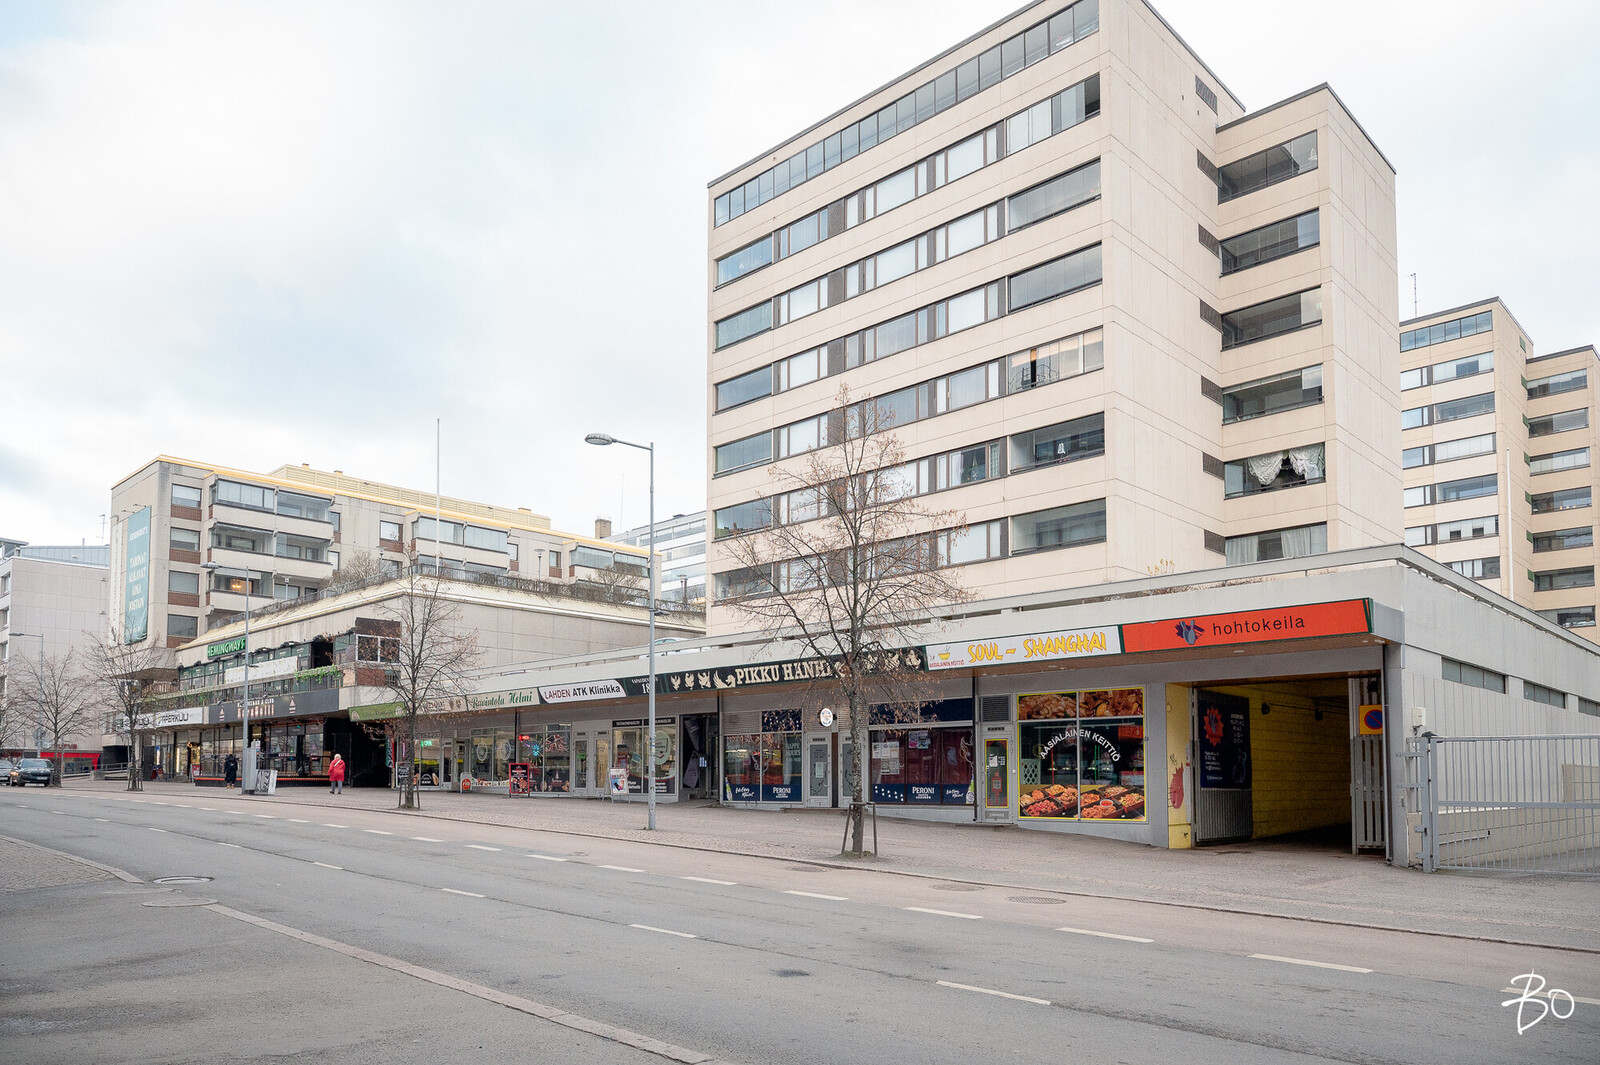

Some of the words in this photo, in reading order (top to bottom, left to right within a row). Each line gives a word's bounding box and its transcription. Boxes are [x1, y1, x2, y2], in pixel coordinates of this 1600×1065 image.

[1212, 616, 1305, 636] hohtokeila
[968, 642, 1004, 663] SOUL
[1023, 632, 1107, 658] SHANGHAI
[735, 664, 780, 685] PIKKU
[782, 660, 832, 681] HANHI
[508, 691, 533, 704] Helmi
[544, 689, 571, 700] LAHDEN
[573, 686, 587, 697] ATK
[589, 684, 621, 695] Klinikka
[1040, 729, 1091, 760] AASIALAINEN
[1092, 732, 1121, 762] KEITTIÖ
[911, 786, 935, 794] PERONI
